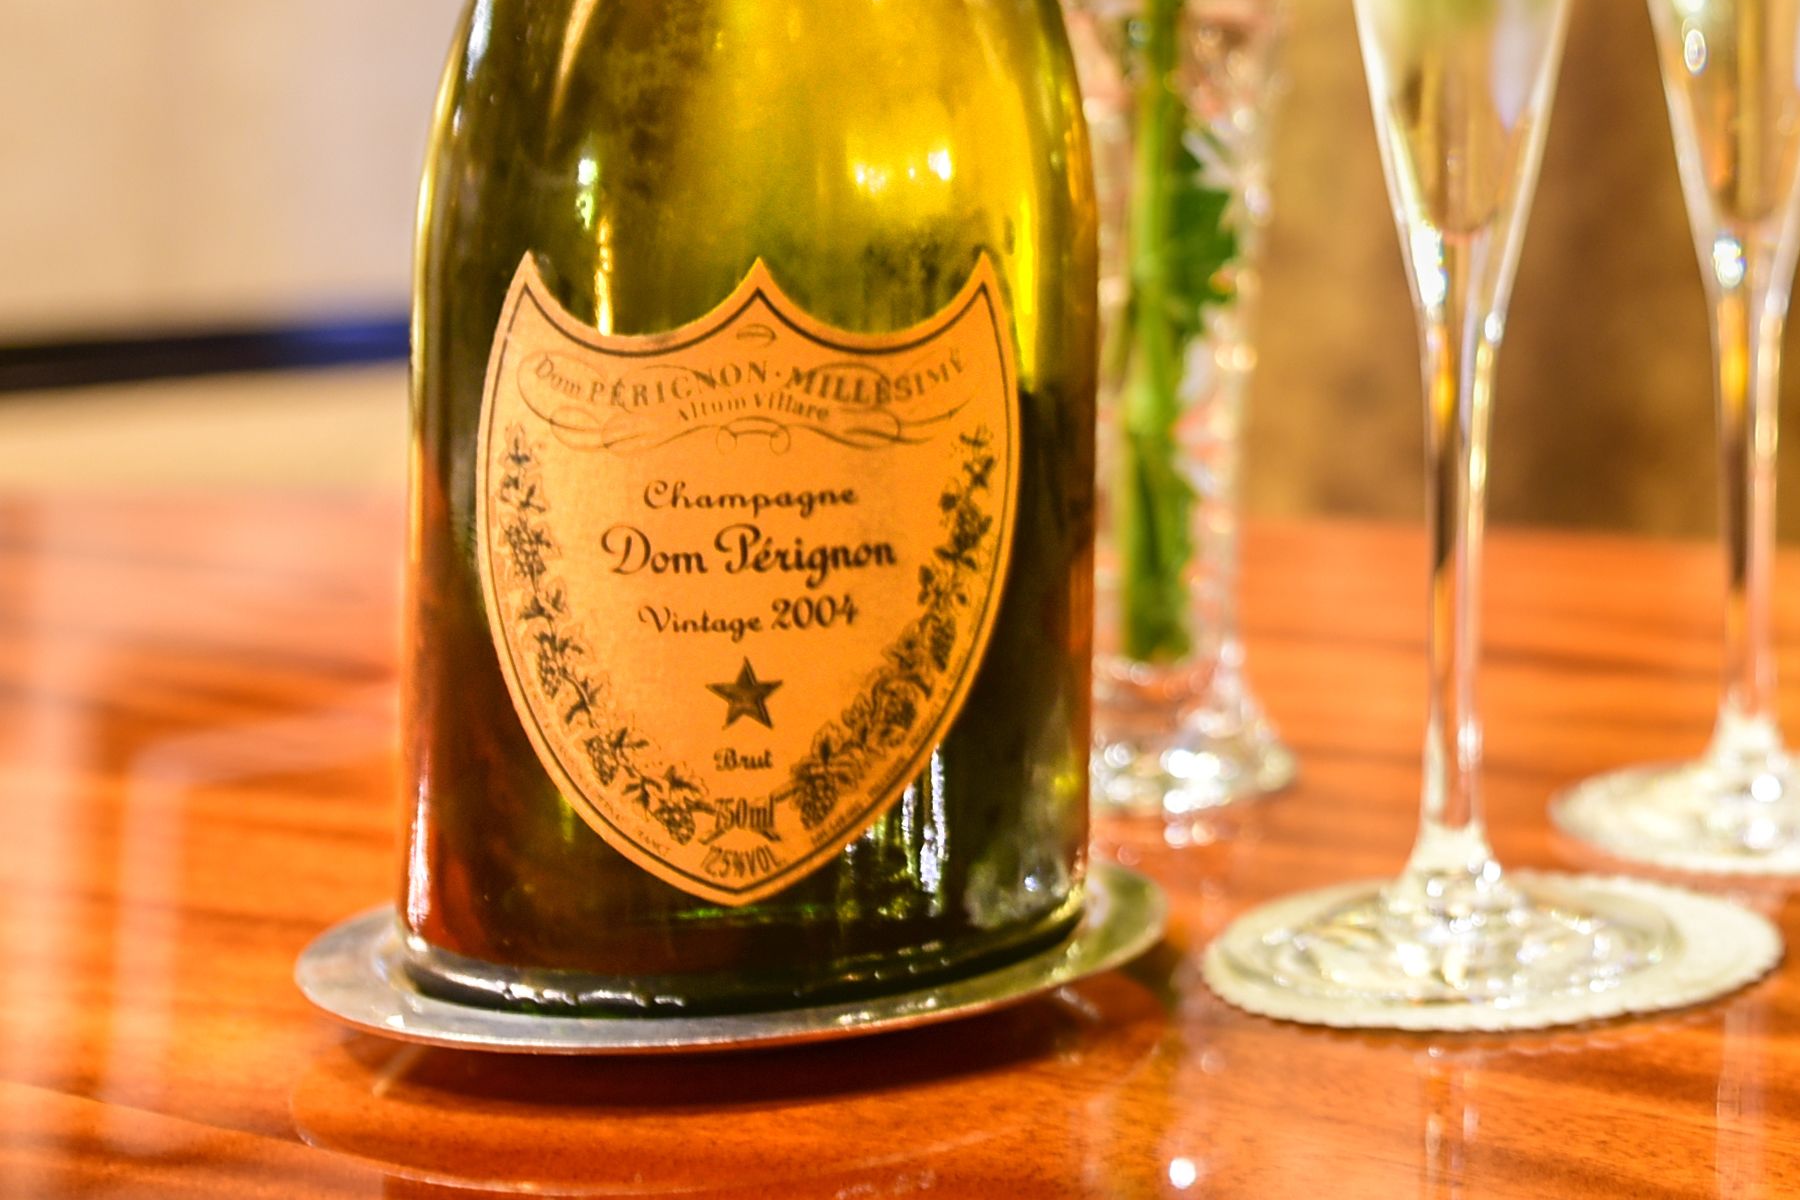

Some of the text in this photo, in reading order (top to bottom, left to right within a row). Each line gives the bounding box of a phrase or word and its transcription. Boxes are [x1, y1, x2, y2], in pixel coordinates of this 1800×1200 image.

[753, 391, 830, 422] Villare
[643, 479, 858, 518] Champagne
[601, 523, 897, 589] Dom Pérignon
[638, 594, 858, 643] Vintage 2004
[714, 748, 772, 771] Brut
[714, 793, 775, 830] 750ml
